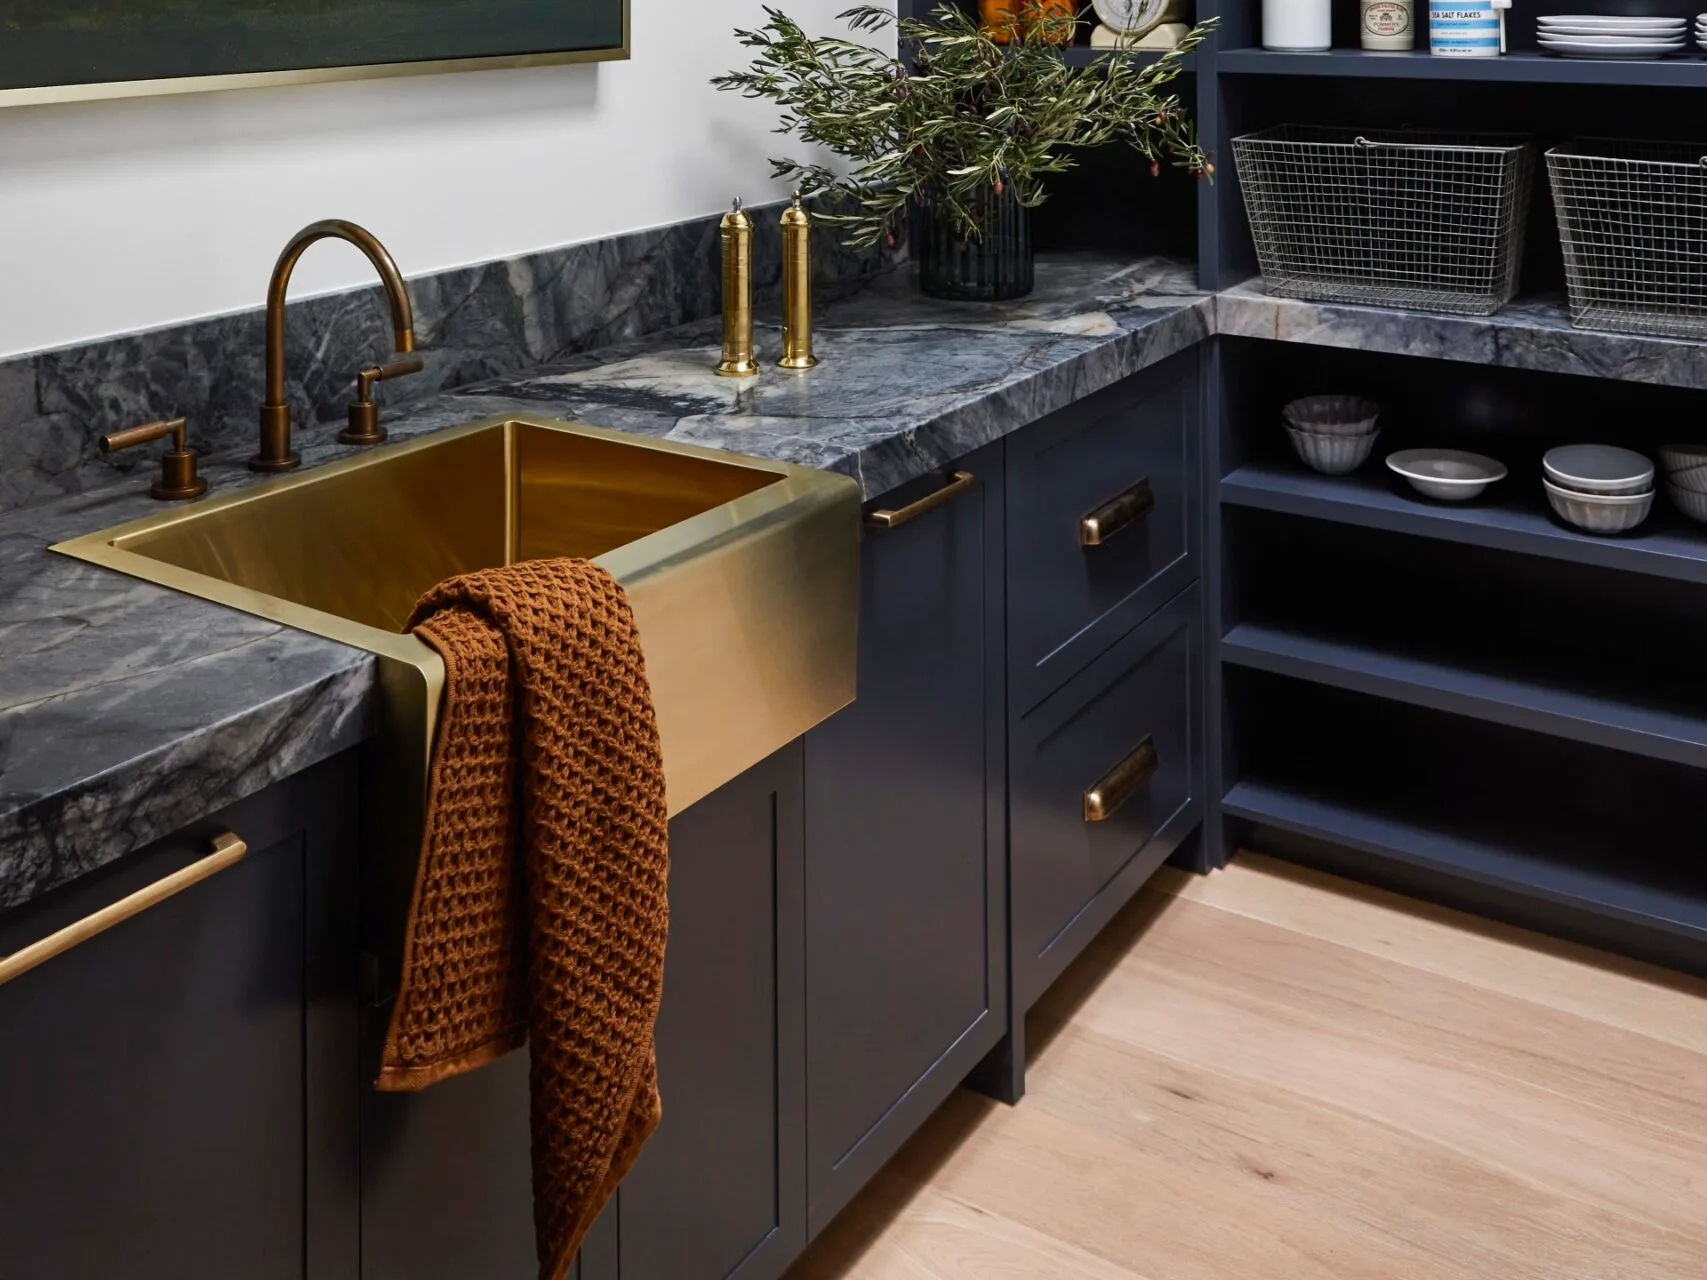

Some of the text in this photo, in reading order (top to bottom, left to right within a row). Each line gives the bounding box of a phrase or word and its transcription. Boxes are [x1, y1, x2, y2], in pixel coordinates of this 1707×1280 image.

[1432, 11, 1481, 19] SEA SALT FLAKES
